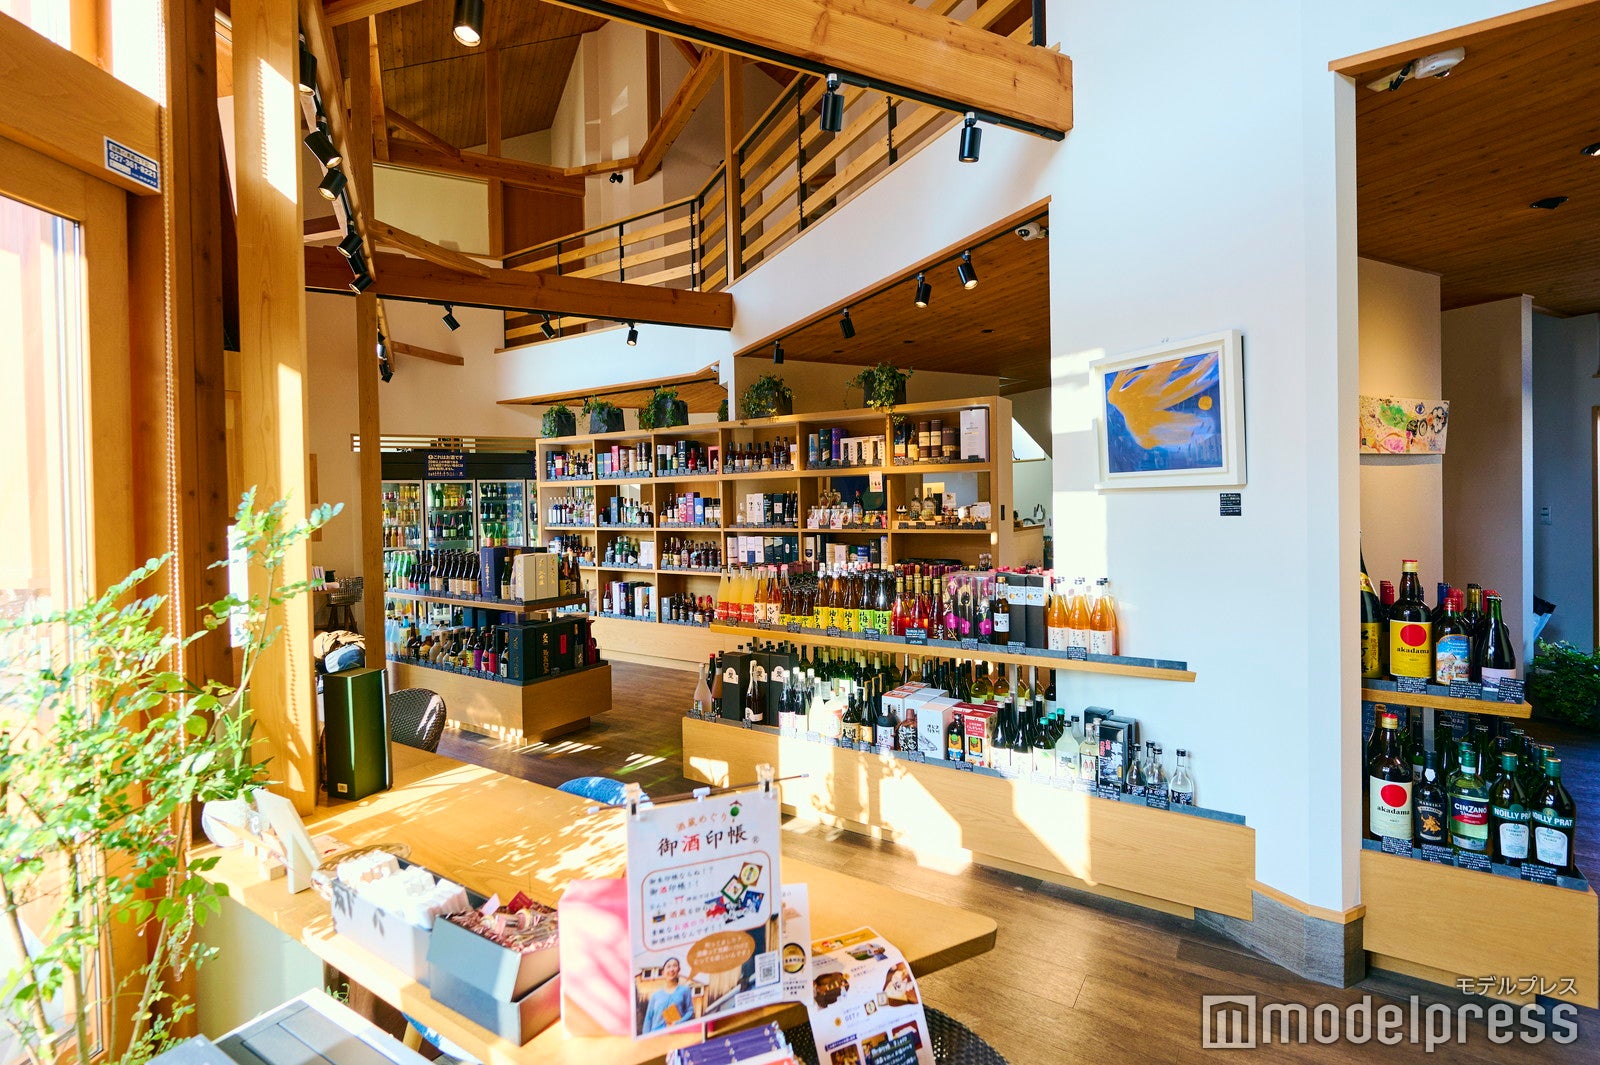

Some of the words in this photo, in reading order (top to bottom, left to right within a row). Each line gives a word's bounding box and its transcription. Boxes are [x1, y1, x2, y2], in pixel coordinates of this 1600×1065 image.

[1396, 646, 1430, 654] akadama
[1376, 805, 1411, 816] akadama
[1454, 802, 1488, 814] CINZANO
[1494, 807, 1520, 820] NOILLY
[1554, 818, 1573, 827] PRAT
[657, 823, 749, 857] 御酒印帳
